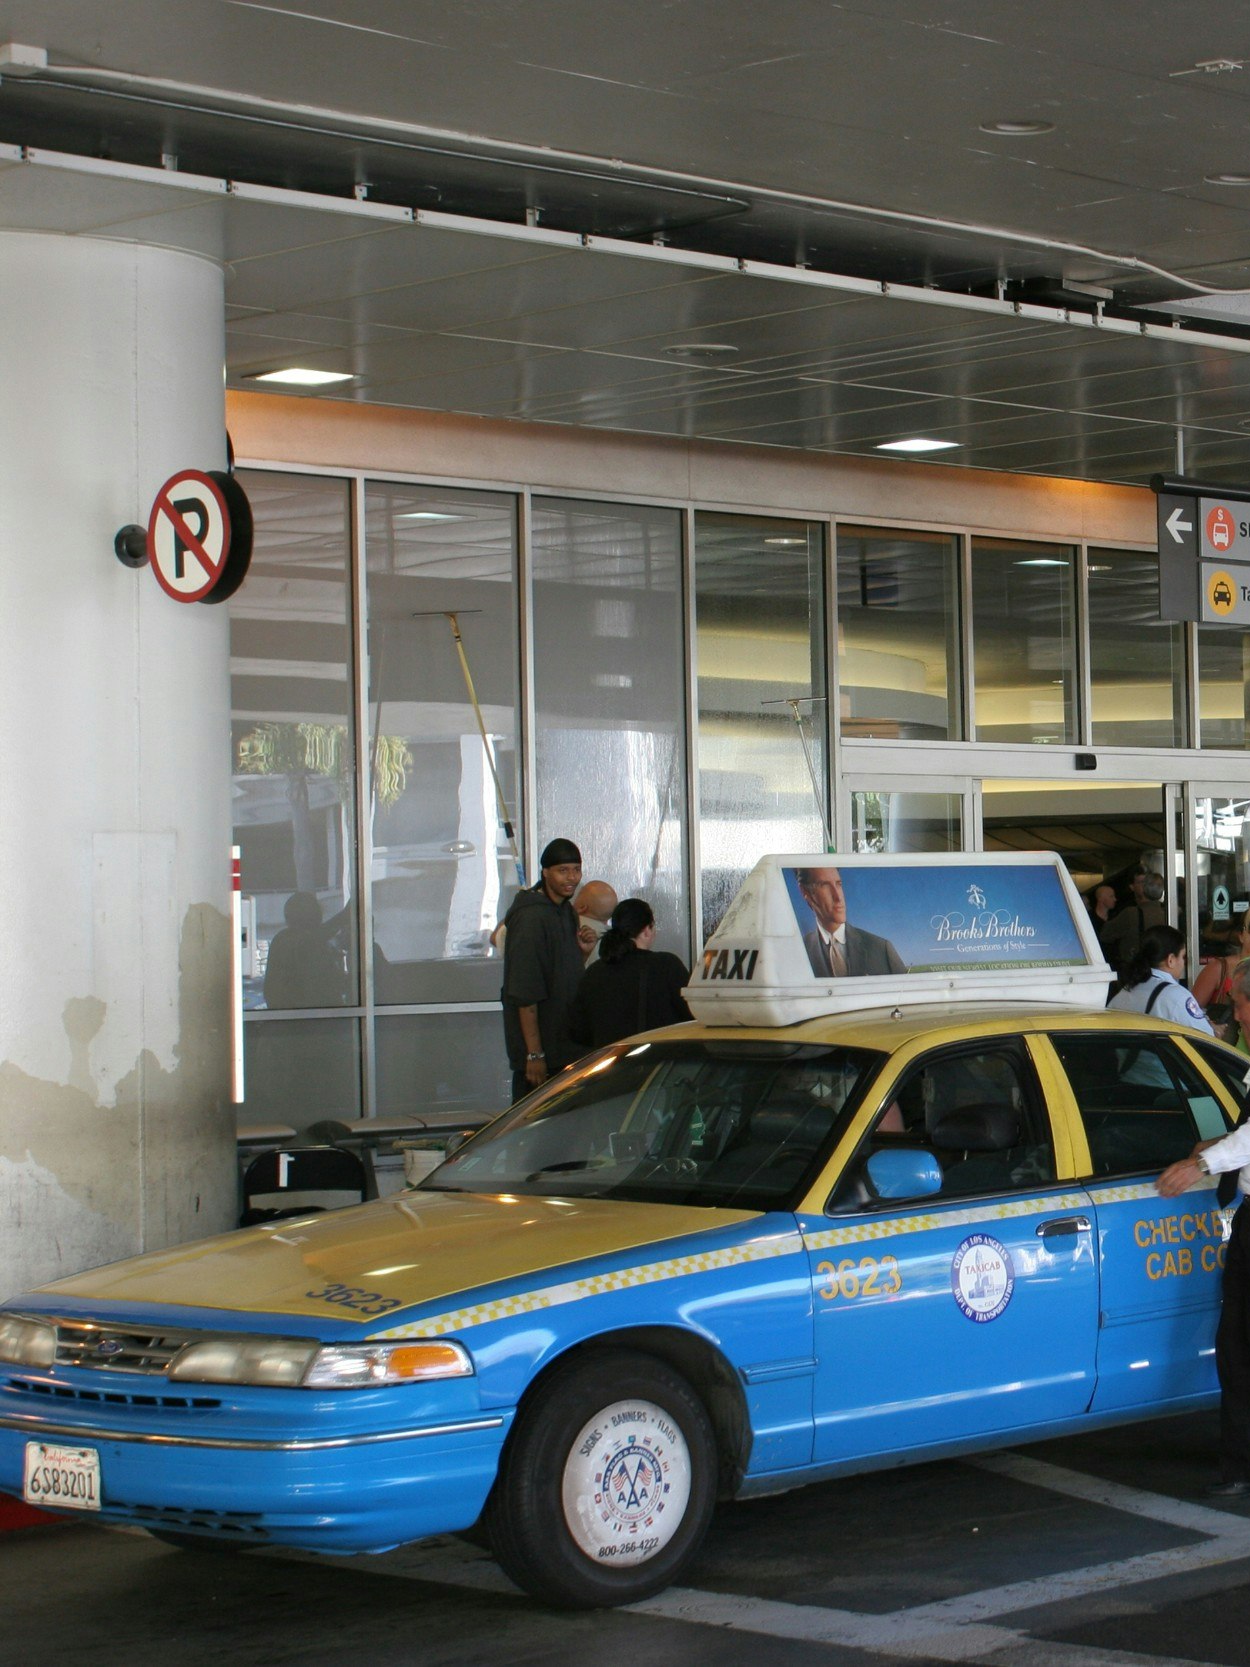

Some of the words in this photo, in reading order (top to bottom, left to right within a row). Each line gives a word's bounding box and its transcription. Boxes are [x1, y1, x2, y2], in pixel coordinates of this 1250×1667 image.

[931, 912, 983, 941] Brooks
[979, 909, 1036, 938] Brothers
[957, 941, 1001, 952] Generations
[1002, 941, 1010, 952] of
[1010, 941, 1026, 951] Style
[702, 949, 759, 980] TAXI
[953, 1251, 964, 1268] CITY
[961, 1243, 969, 1251] OF
[969, 1235, 982, 1245] LOS
[984, 1237, 1009, 1260] ANGELES
[1146, 1248, 1193, 1280] CAB
[817, 1255, 902, 1299] 3623
[965, 1261, 1001, 1275] TAXICAB
[305, 1284, 402, 1314] 3623
[975, 1279, 1014, 1321] TRANSPORTATION
[580, 1429, 603, 1457] SIGNS
[611, 1411, 647, 1427] BANNERS
[658, 1420, 677, 1444] FLAGS
[31, 1466, 95, 1500] 6S83201
[599, 1537, 659, 1557] 800-266-4222
